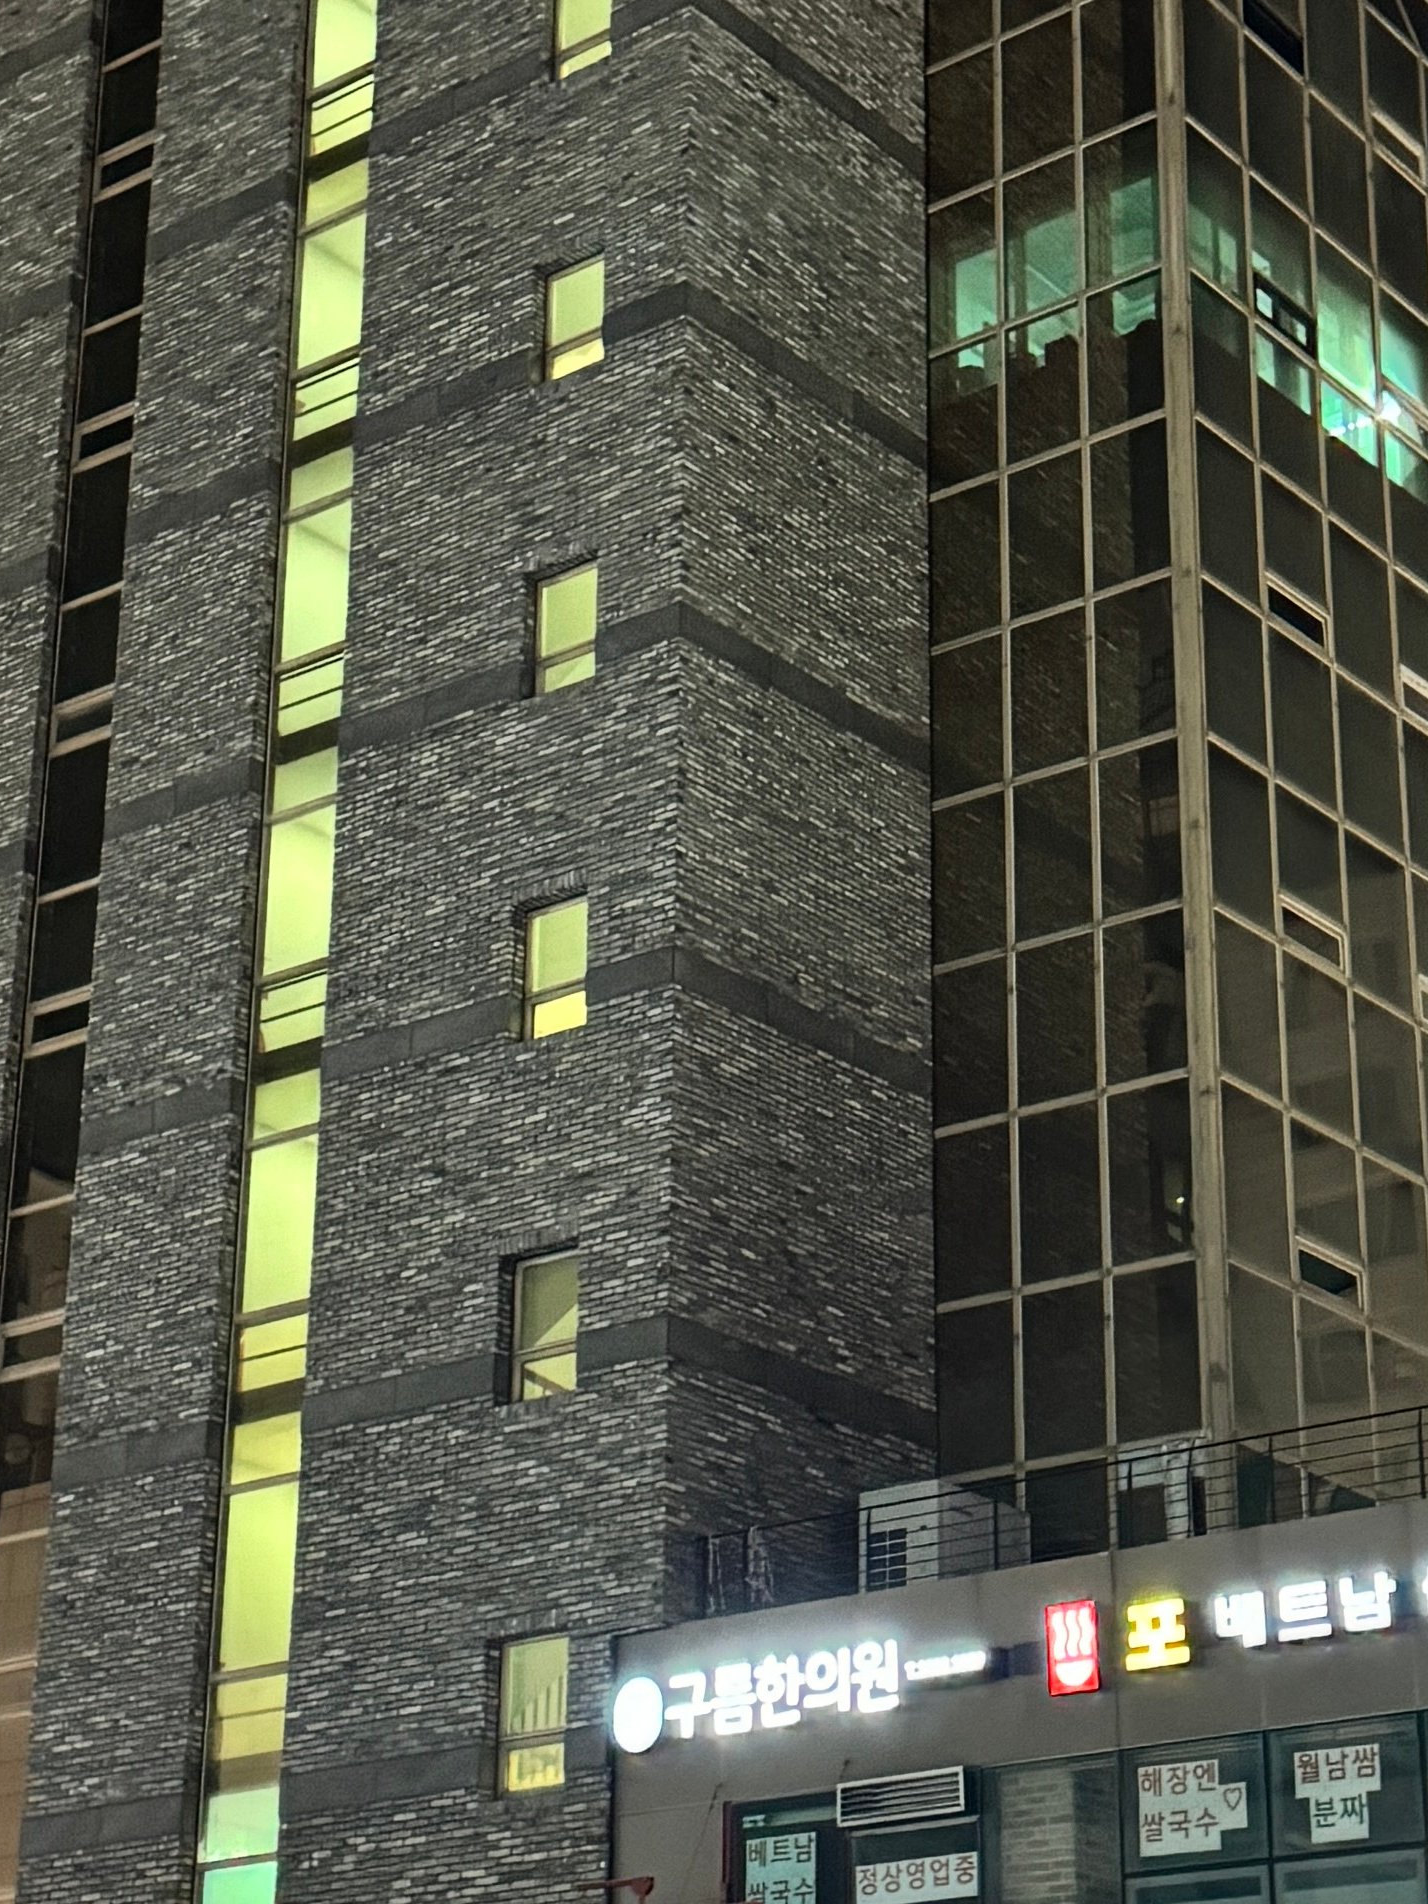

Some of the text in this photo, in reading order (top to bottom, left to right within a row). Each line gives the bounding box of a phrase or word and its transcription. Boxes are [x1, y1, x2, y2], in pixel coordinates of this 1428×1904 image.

[1126, 1597, 1191, 1672] 포
[1213, 1568, 1397, 1648] 베트남
[663, 1637, 900, 1741] 구름한의원
[1139, 1764, 1217, 1797] 해장엔
[1297, 1747, 1380, 1785] 월남쌈
[1141, 1806, 1220, 1843] 쌀국수
[1312, 1793, 1367, 1829] 분짜
[748, 1834, 814, 1868] 베트남
[858, 1855, 977, 1896] 정상영업중
